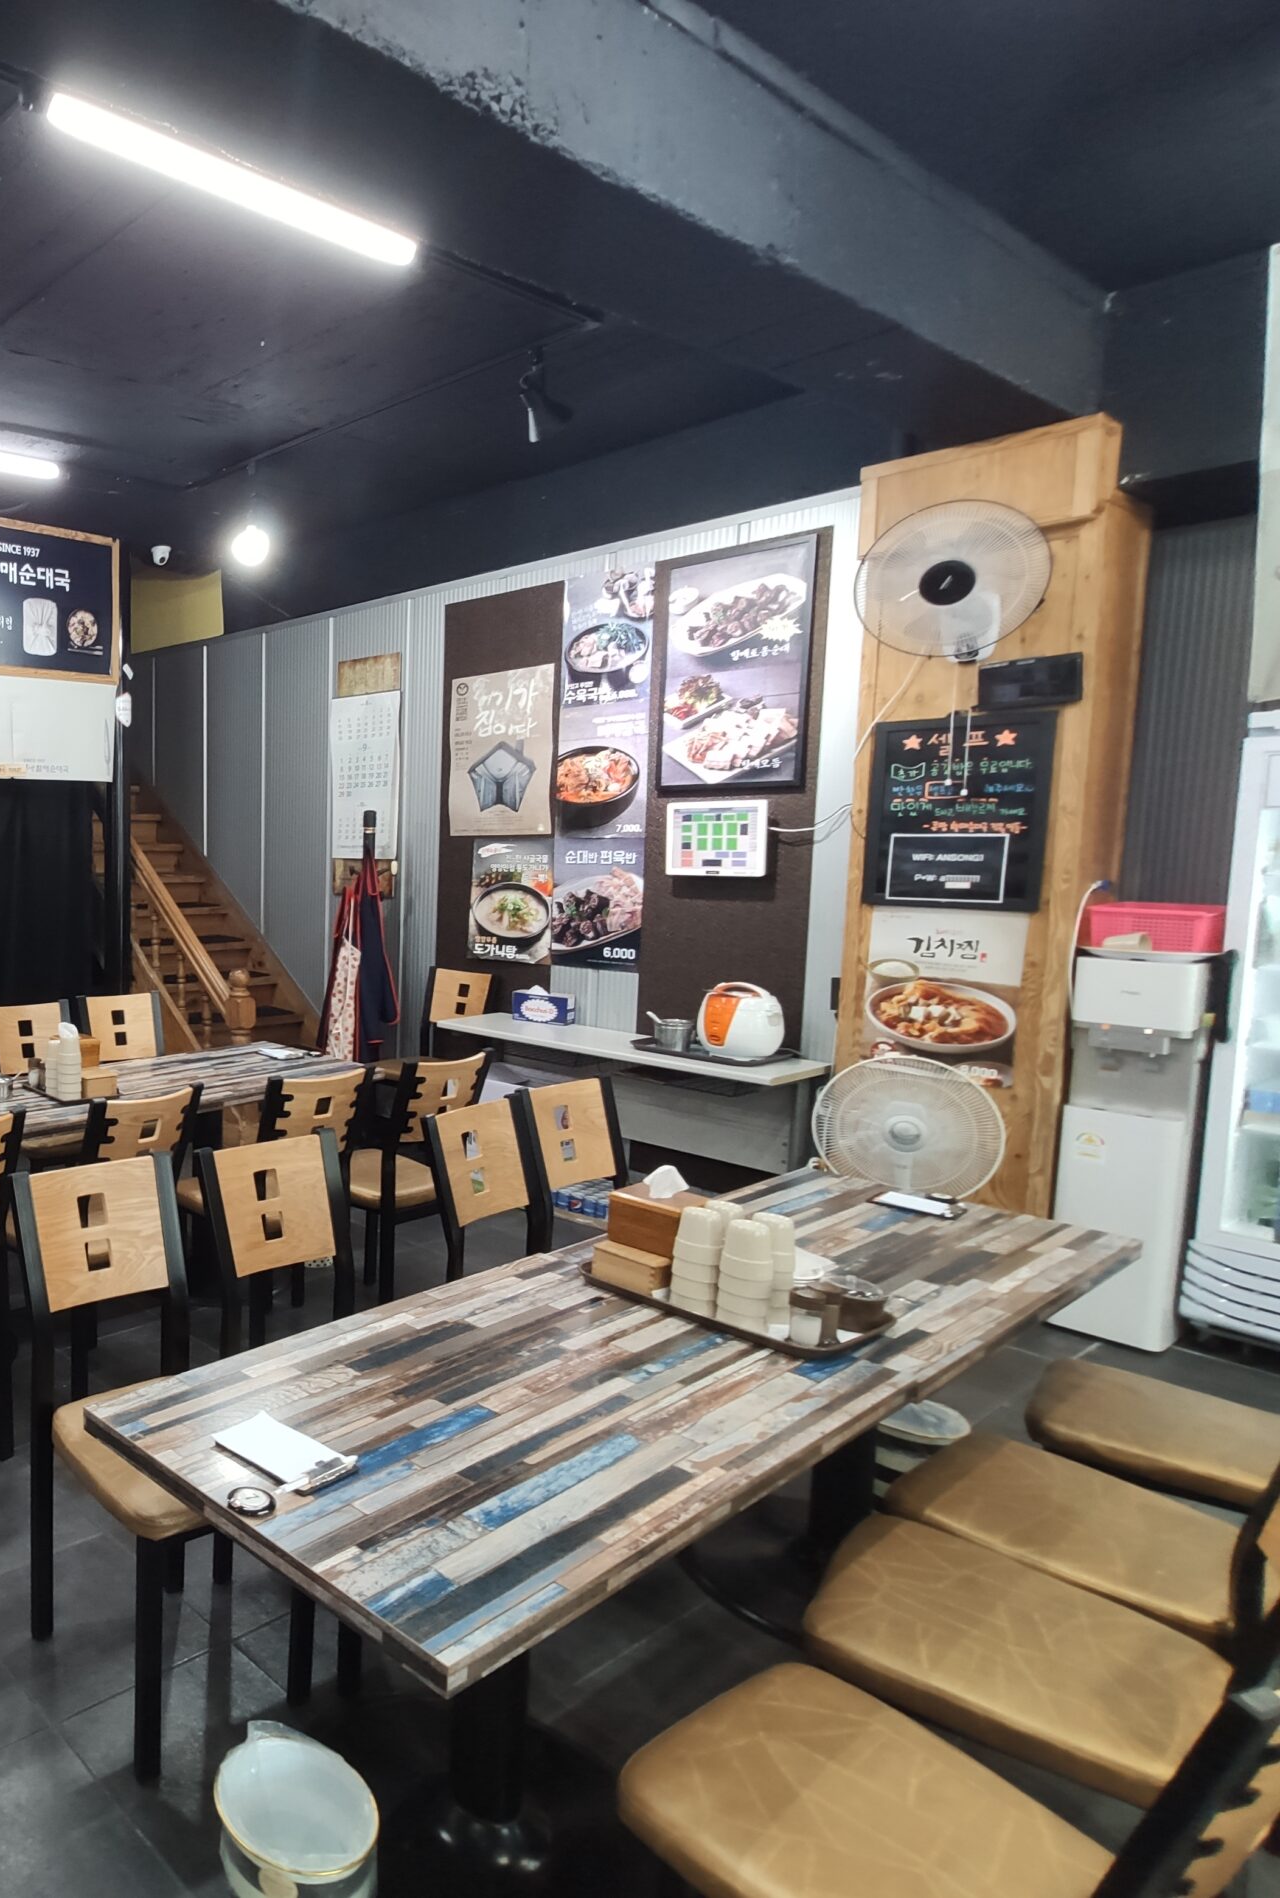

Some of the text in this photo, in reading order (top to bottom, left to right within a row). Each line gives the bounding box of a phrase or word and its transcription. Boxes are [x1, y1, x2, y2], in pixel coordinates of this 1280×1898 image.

[23, 546, 40, 558] 1937
[474, 710, 538, 738] 집이다
[890, 801, 933, 817] 맛있게
[565, 850, 639, 865] 순대반 편육반
[473, 943, 523, 959] 도가니탕
[602, 946, 638, 960] 6,000
[906, 935, 980, 960] 김치찜
